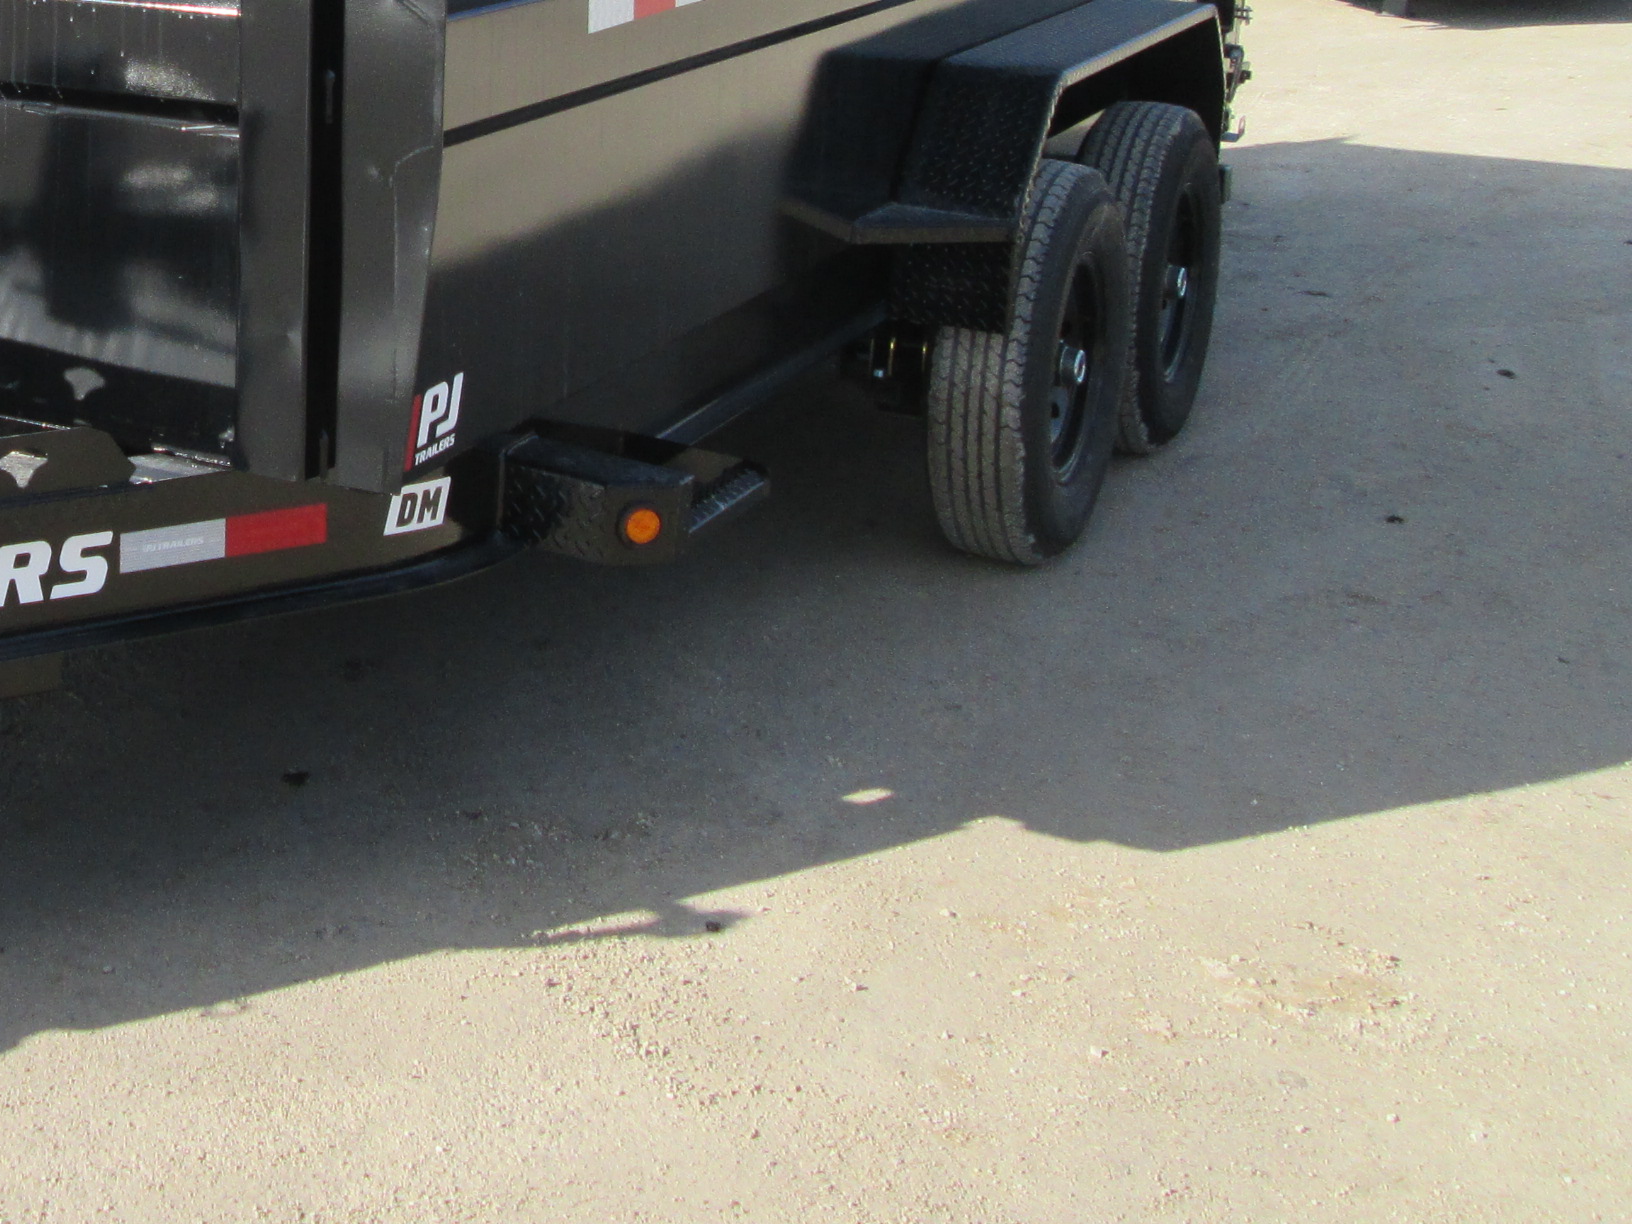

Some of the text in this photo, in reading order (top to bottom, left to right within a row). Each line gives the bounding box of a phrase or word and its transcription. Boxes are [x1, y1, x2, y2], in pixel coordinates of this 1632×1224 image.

[417, 372, 464, 448] PJ
[414, 432, 456, 466] TRAILERS
[395, 486, 443, 528] DM
